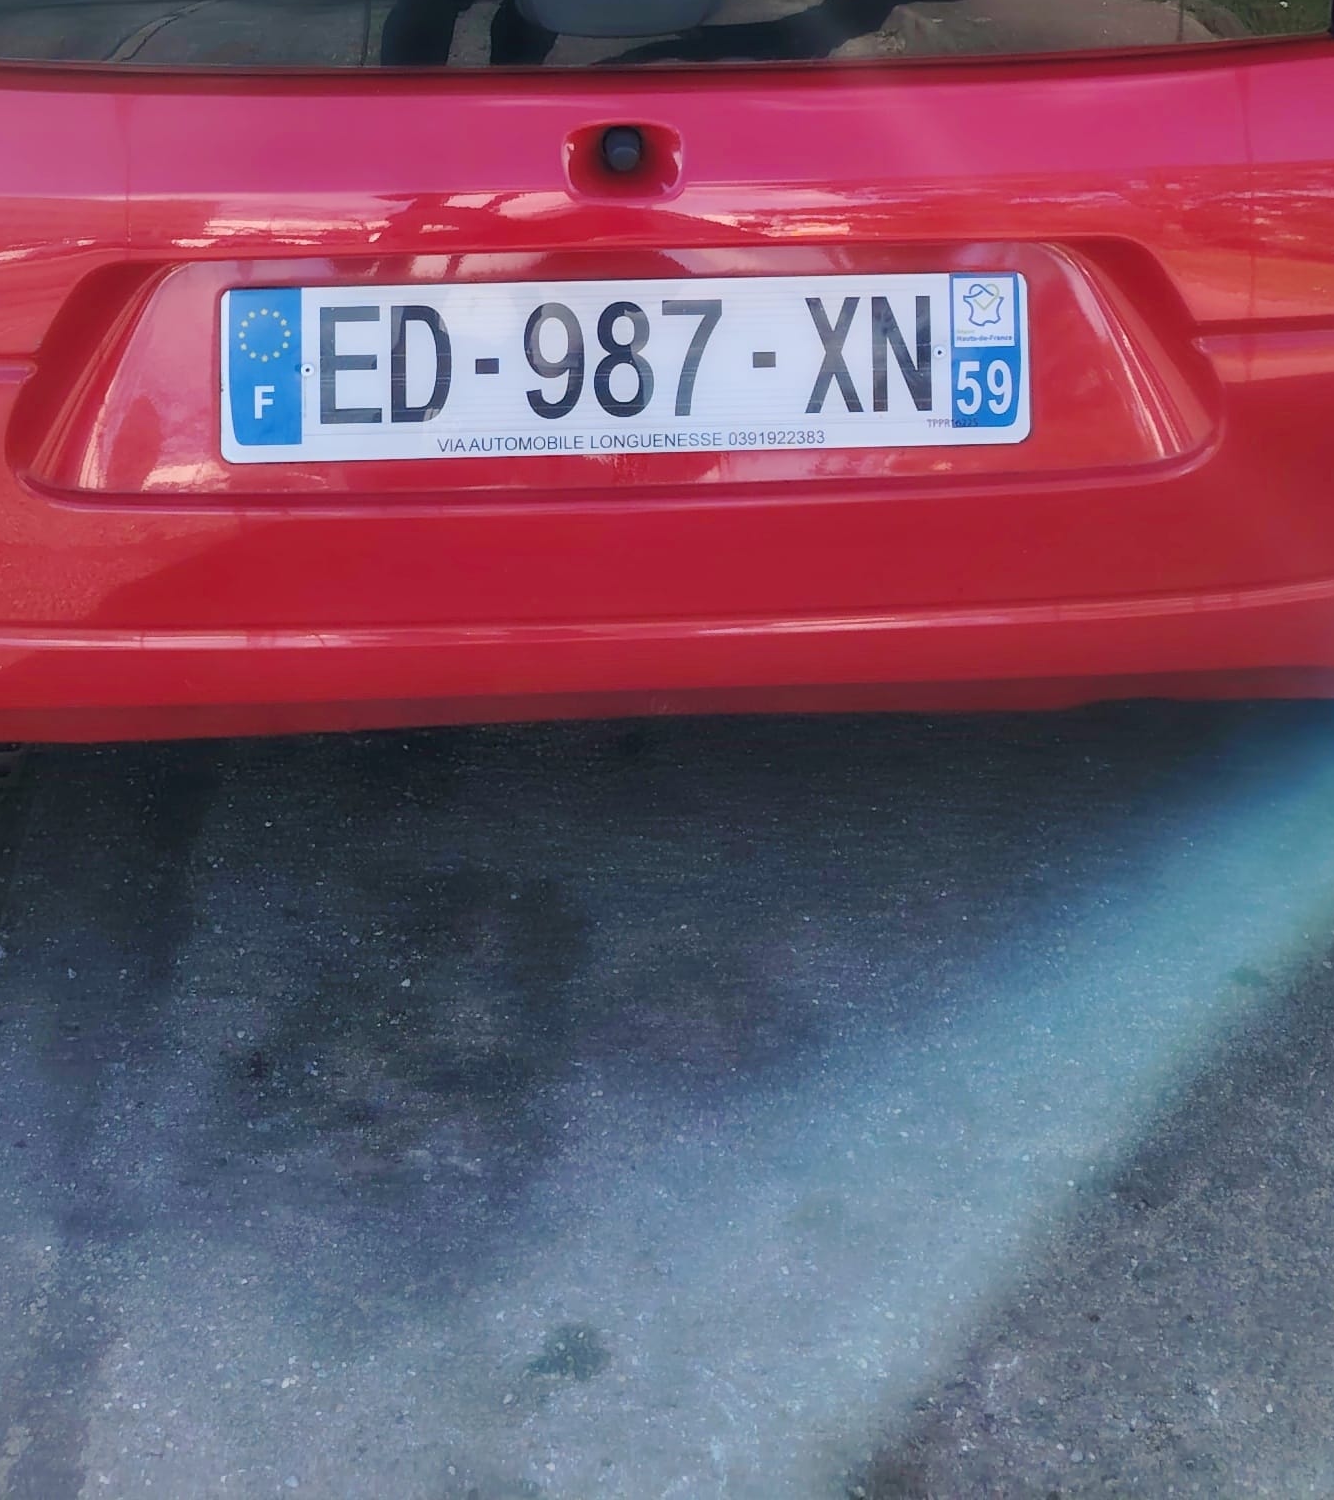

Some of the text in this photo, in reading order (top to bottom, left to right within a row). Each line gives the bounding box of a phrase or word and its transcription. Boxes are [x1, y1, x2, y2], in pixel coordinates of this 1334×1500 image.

[254, 385, 275, 419] F
[956, 359, 1013, 415] 59
[437, 429, 826, 453] VIA AUTOMOBILE LONGUENESSE 0391922383
